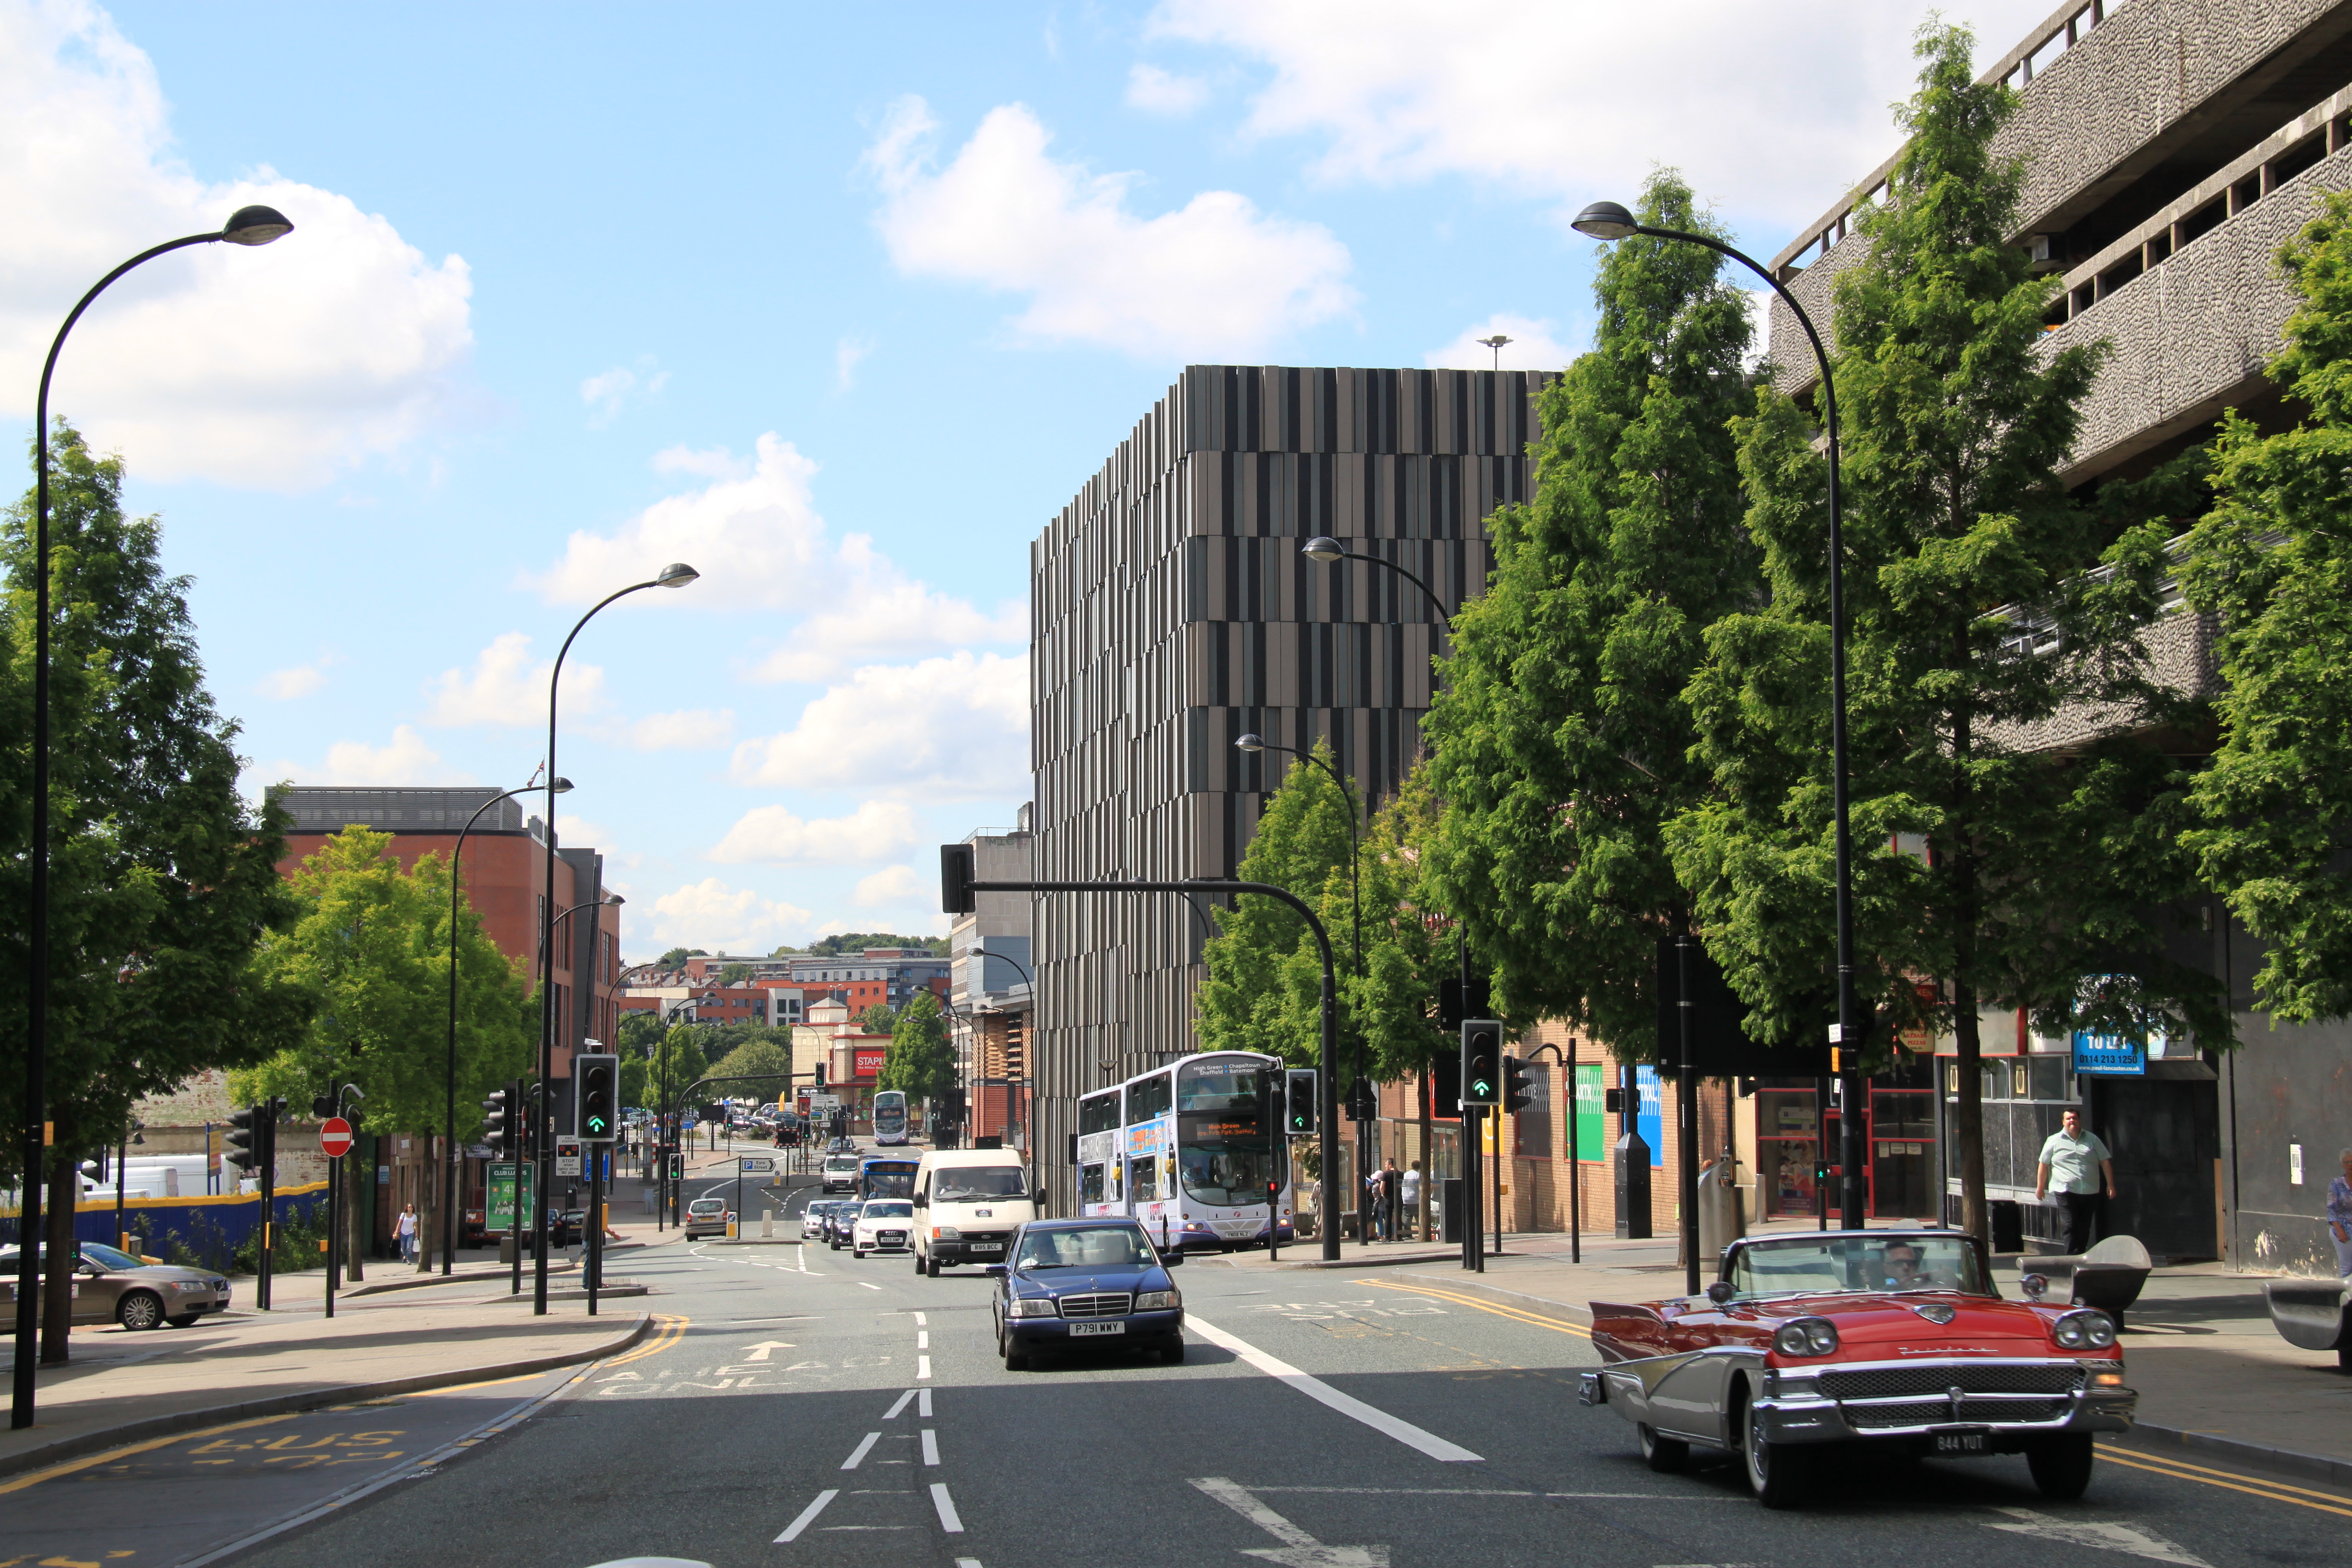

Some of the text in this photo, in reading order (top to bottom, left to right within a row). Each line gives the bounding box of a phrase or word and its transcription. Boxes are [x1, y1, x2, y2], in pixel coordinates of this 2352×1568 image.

[2087, 1035, 2103, 1049] TO
[857, 1057, 885, 1065] STAPL
[2118, 1055, 2138, 1064] 1250
[1076, 1323, 1118, 1333] P791 WWY
[1937, 1435, 1983, 1450] 844 YUT
